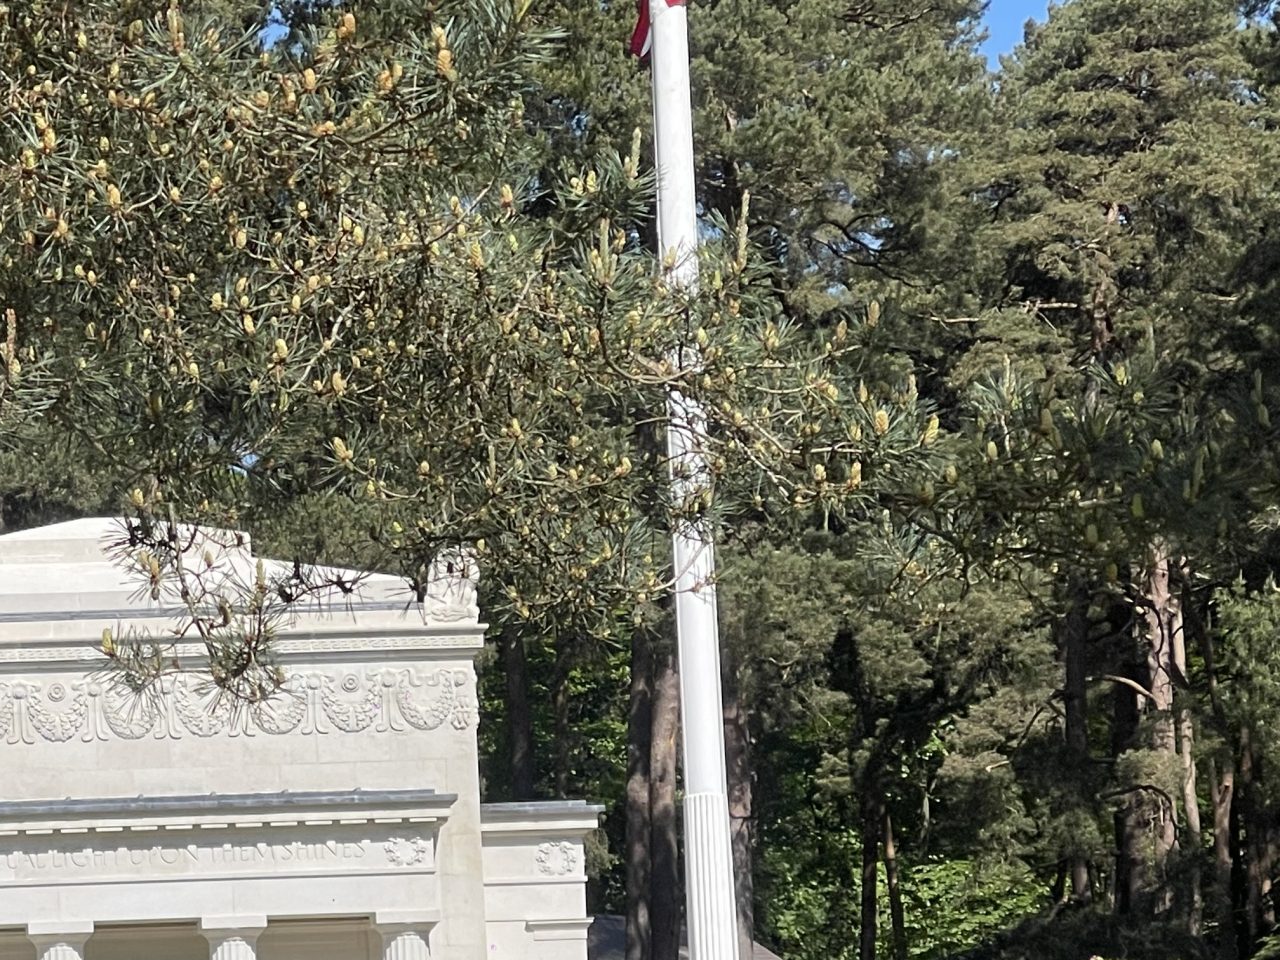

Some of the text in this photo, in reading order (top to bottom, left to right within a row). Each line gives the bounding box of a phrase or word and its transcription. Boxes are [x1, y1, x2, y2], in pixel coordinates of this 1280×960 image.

[52, 850, 124, 869] LIGHT
[129, 847, 199, 866] UPON
[208, 845, 276, 864] THEM
[280, 842, 366, 861] SHINES
